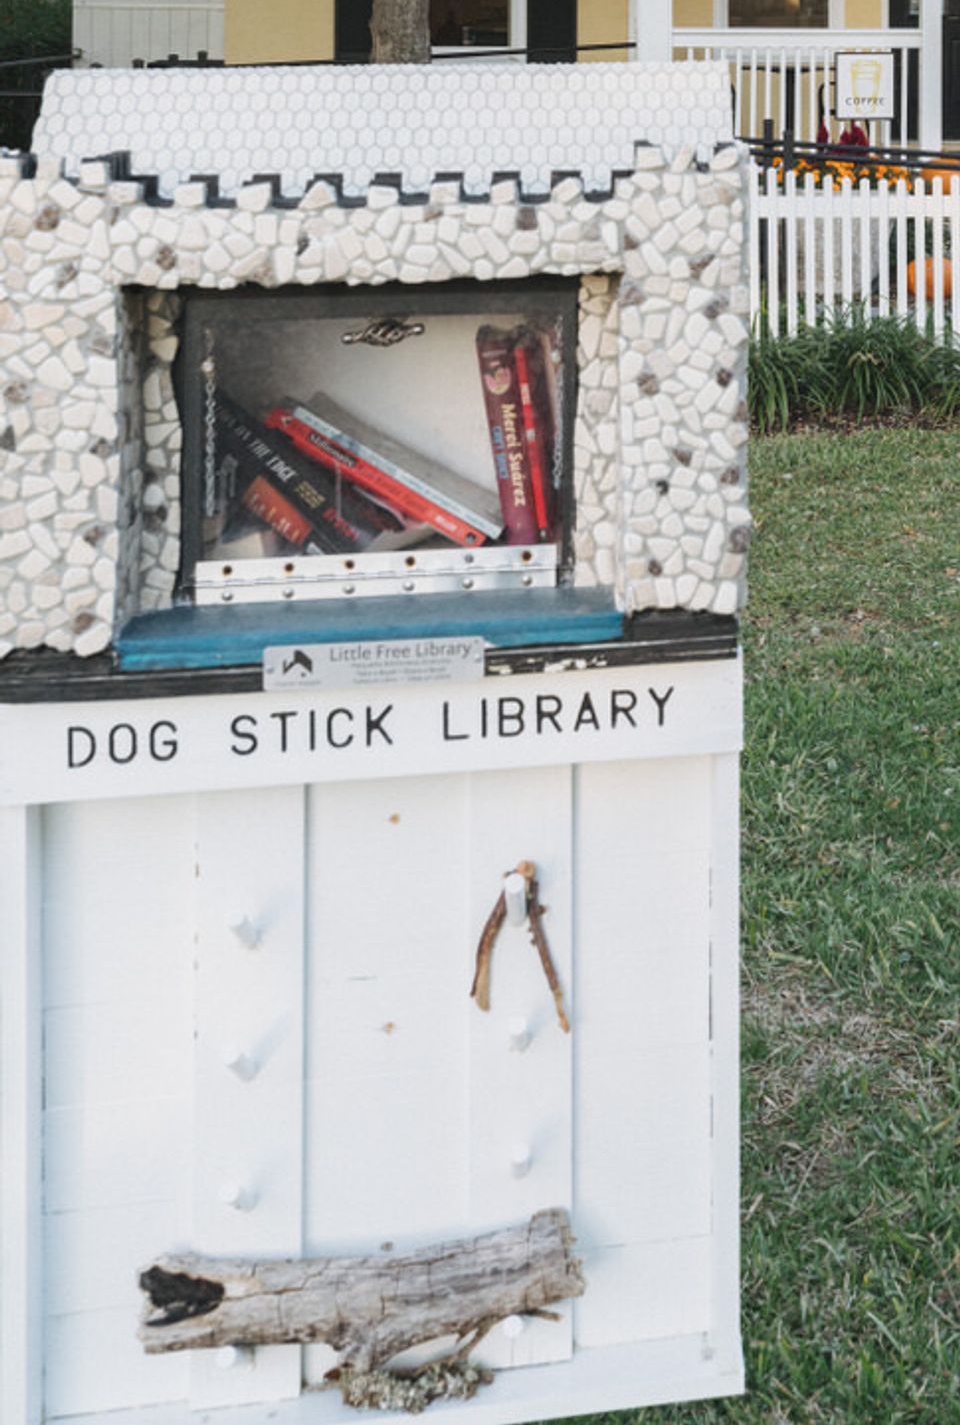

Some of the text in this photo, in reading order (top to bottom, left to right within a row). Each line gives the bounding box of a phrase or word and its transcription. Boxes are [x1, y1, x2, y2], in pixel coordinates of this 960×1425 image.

[845, 96, 887, 106] COFFEE
[330, 640, 473, 662] Little Free Library
[66, 687, 676, 769] DOG STICK LIBRARY
